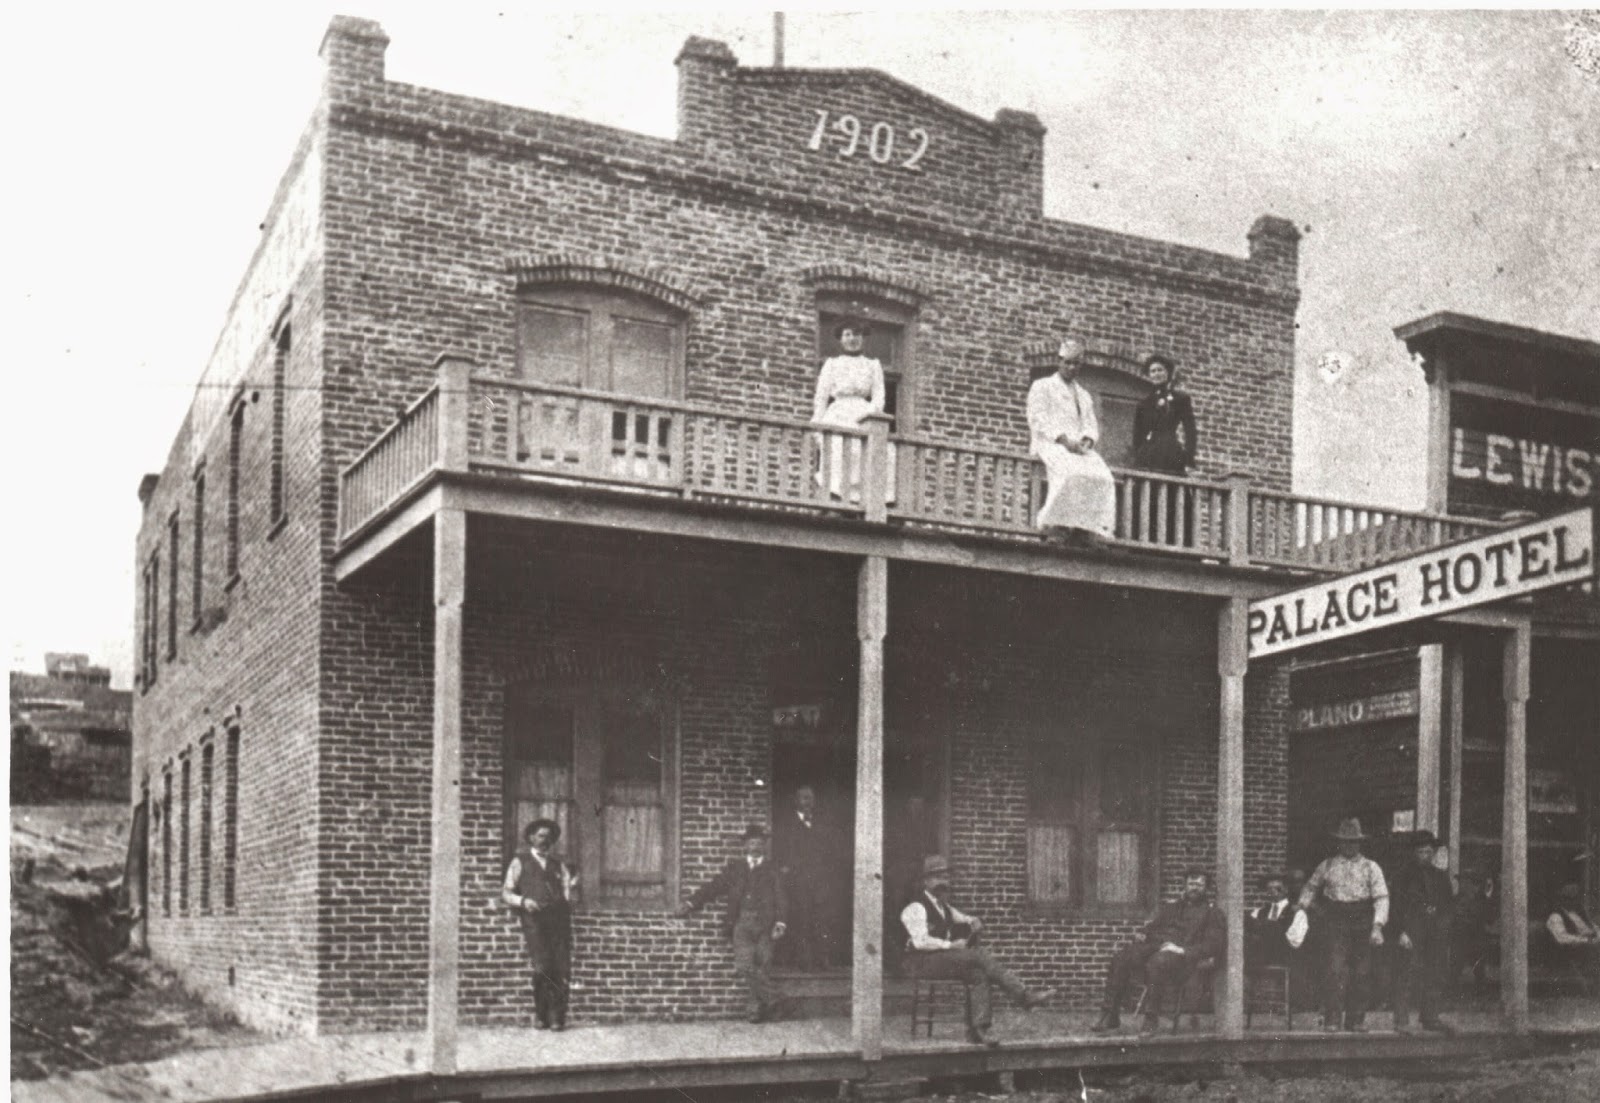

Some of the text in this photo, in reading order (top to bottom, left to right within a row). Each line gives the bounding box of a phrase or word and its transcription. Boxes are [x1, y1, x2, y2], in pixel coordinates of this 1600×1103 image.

[808, 109, 929, 171] 1902
[1453, 428, 1600, 497] LEWIS
[1249, 526, 1588, 648] PALACE HOTEL
